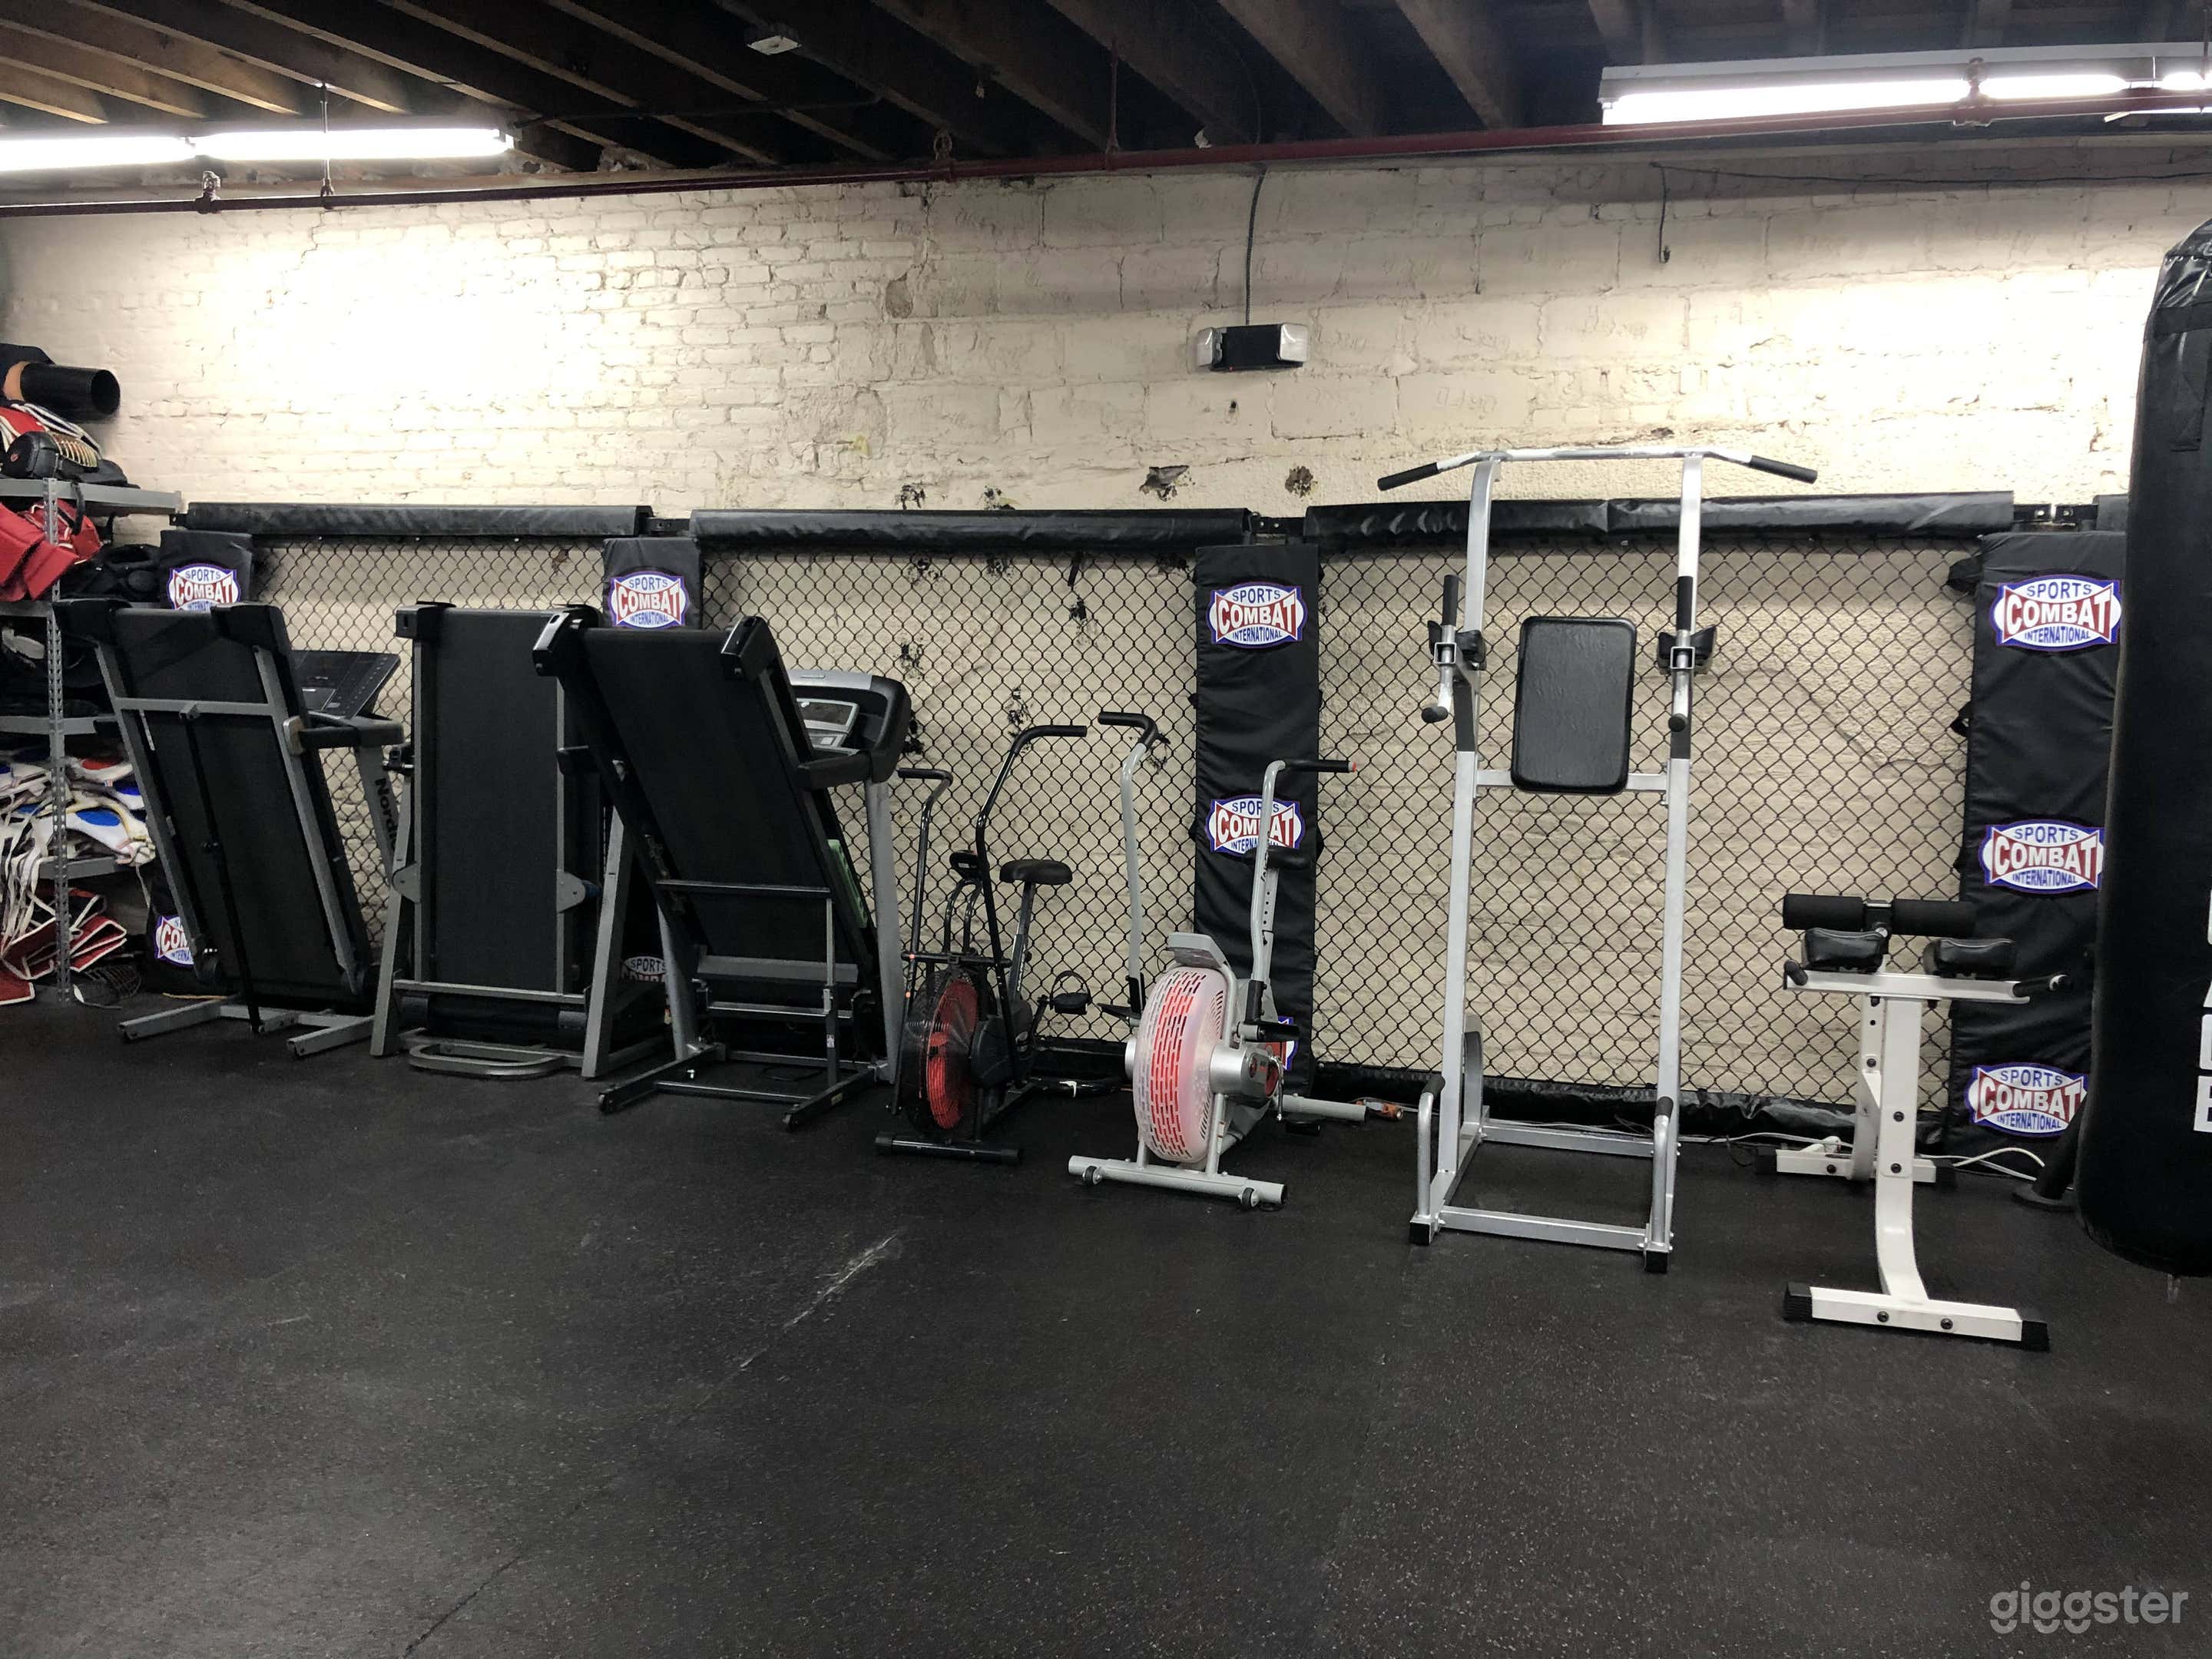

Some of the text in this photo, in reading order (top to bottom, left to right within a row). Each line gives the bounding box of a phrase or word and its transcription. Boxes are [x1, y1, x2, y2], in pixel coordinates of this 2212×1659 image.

[185, 568, 221, 581] SPORTS
[175, 574, 233, 605] COMBAT
[628, 577, 667, 591] SPORTS
[2027, 581, 2092, 599] SPORTS
[618, 583, 679, 618] COMBAT
[1232, 588, 1281, 604] SPORTS
[630, 611, 669, 625] INTERNATIONAL
[1218, 593, 1295, 634] COMBAT
[2006, 588, 2111, 635] COMBAT
[1232, 627, 1282, 642] INTERNATIONAL
[2025, 626, 2091, 644] INTERNATIONAL
[1232, 800, 1280, 815] SPORS
[1217, 808, 1293, 846] COMAT
[2015, 826, 2079, 843] SPORTS
[1995, 835, 2098, 879] COMBAT
[2012, 869, 2078, 887] INTERNATIONAL
[161, 923, 188, 952] COM
[2000, 1069, 2064, 1087] SPORTS
[1980, 1077, 2081, 1122] COMBAT
[1997, 1113, 2061, 1130] INTERNATIONAL
